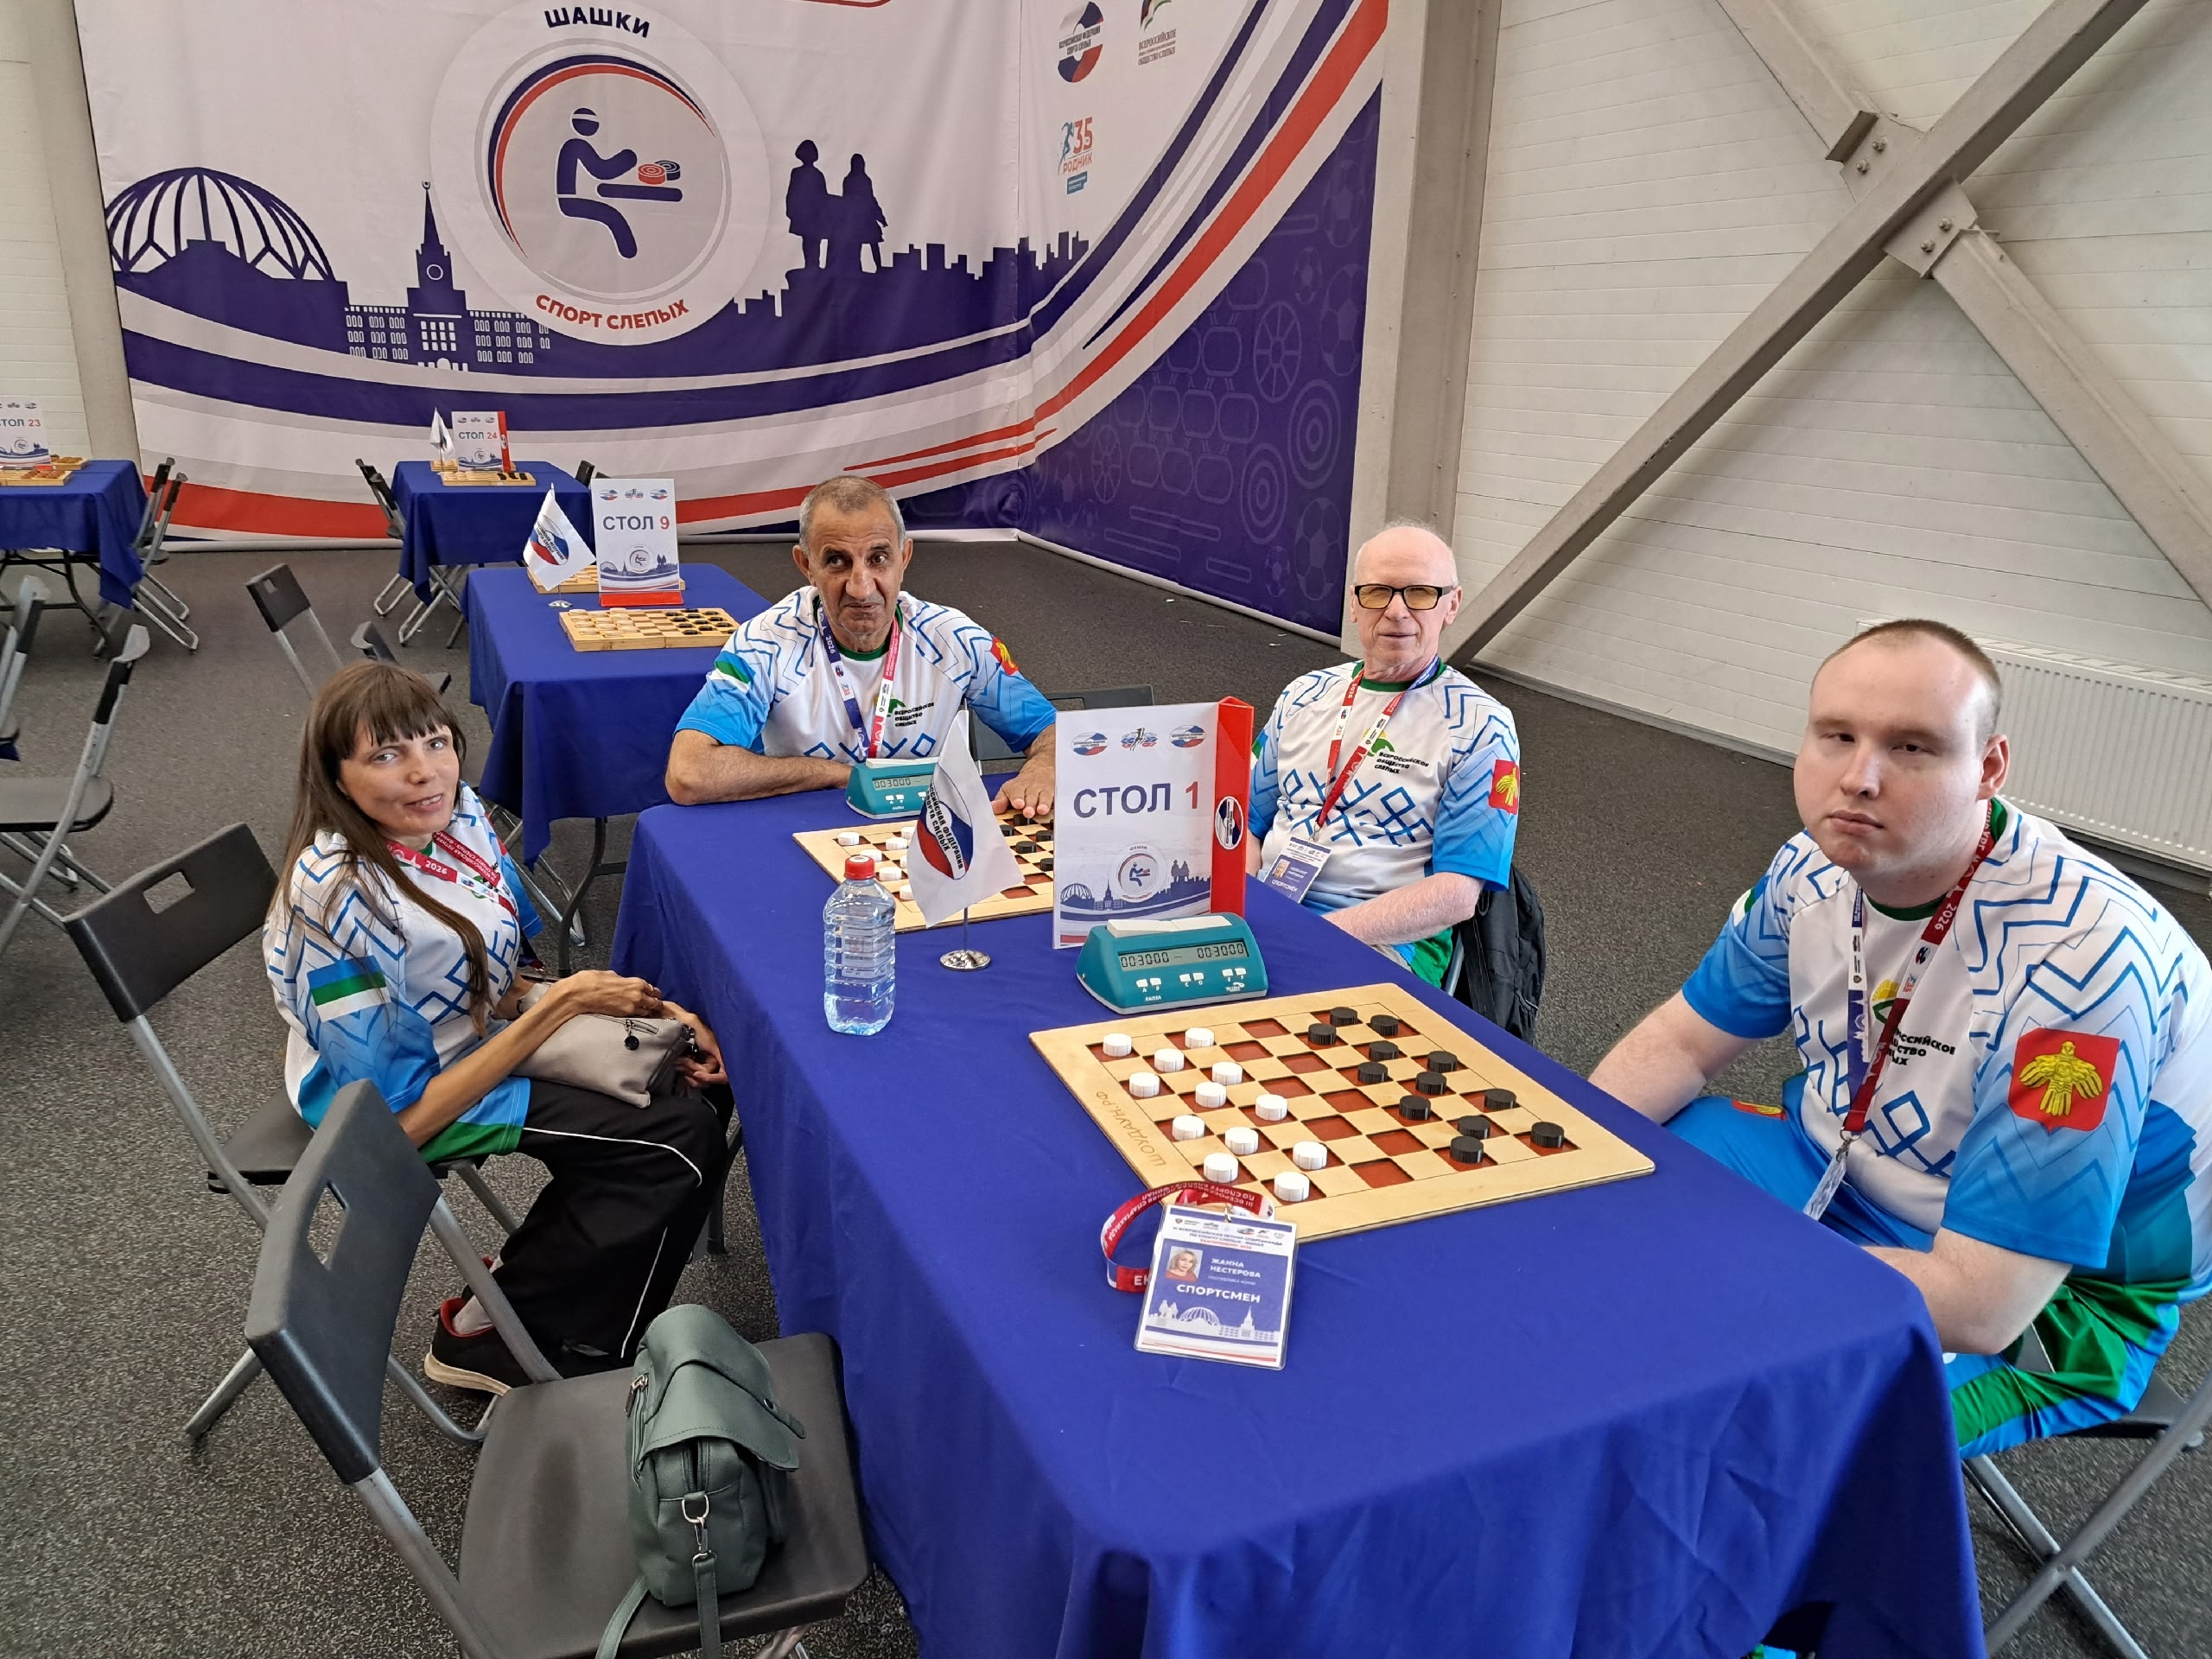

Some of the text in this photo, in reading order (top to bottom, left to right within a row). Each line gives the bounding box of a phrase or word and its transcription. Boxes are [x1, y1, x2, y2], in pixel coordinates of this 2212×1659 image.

[543, 6, 650, 38] ШАШКИ
[1073, 117, 1092, 154] 35
[1063, 152, 1093, 175] РОДНИК
[536, 294, 690, 329] СПОРТ СЛЕПЫХ
[0, 418, 24, 427] ТОЛ
[602, 516, 670, 530] СТОЛ 9
[1074, 781, 1199, 818] СТОЛ 1
[932, 820, 950, 851] СЛЕПЫХ
[943, 826, 963, 869] ФЕДЕРАЦИЯ
[424, 861, 448, 874] 2026
[1934, 903, 1957, 931] 2026
[1896, 1027, 1956, 1055] ССИЙСКОЕ
[1096, 1091, 1166, 1166] ШОУДАУН.РФ
[1210, 1265, 1261, 1279] НЕСТЕРОВА
[1211, 1257, 1244, 1268] ЖАННА
[1176, 1284, 1261, 1303] СПОРТСМЕН
